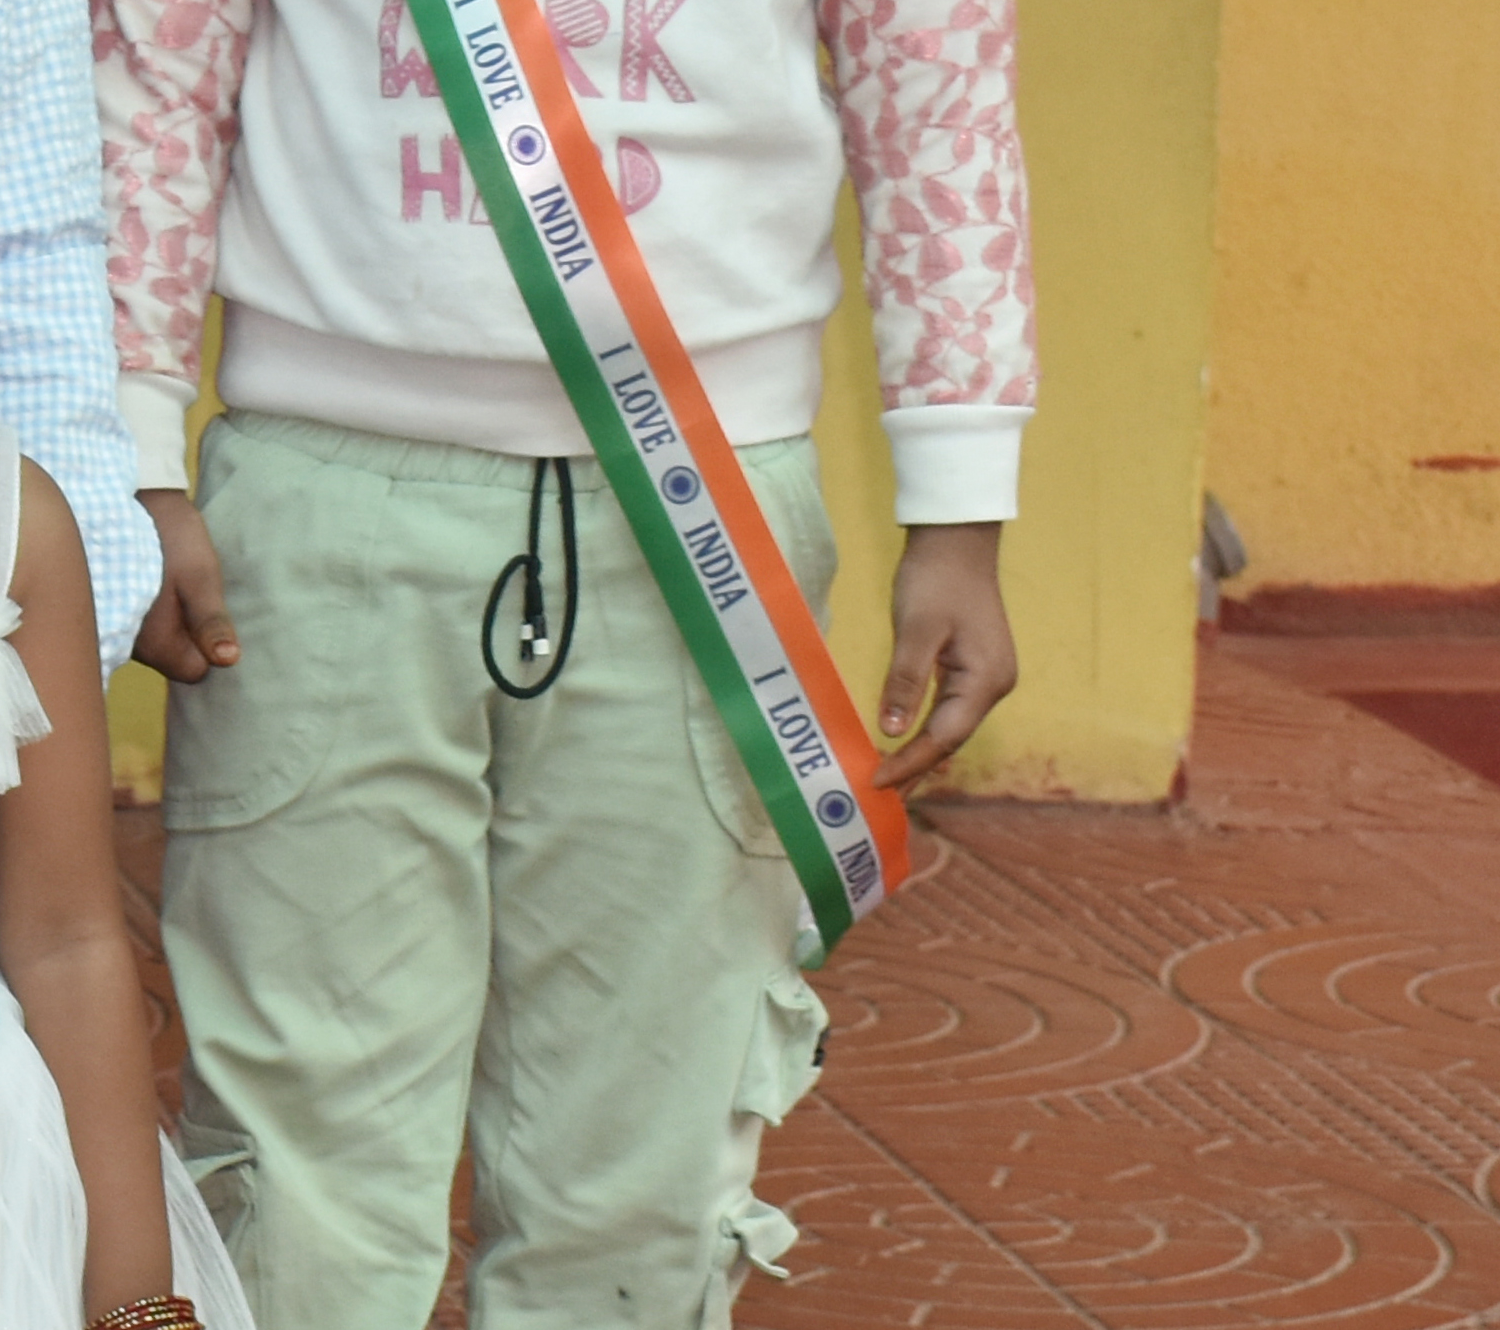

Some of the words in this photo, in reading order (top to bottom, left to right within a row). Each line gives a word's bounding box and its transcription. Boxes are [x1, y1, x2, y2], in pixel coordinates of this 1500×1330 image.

[466, 23, 524, 109] LOVE
[529, 183, 595, 283] INDIA
[598, 342, 633, 361] I
[611, 370, 676, 454] LOVE
[682, 519, 749, 614] INDIA
[752, 666, 787, 686] I
[768, 694, 833, 779] LOVE
